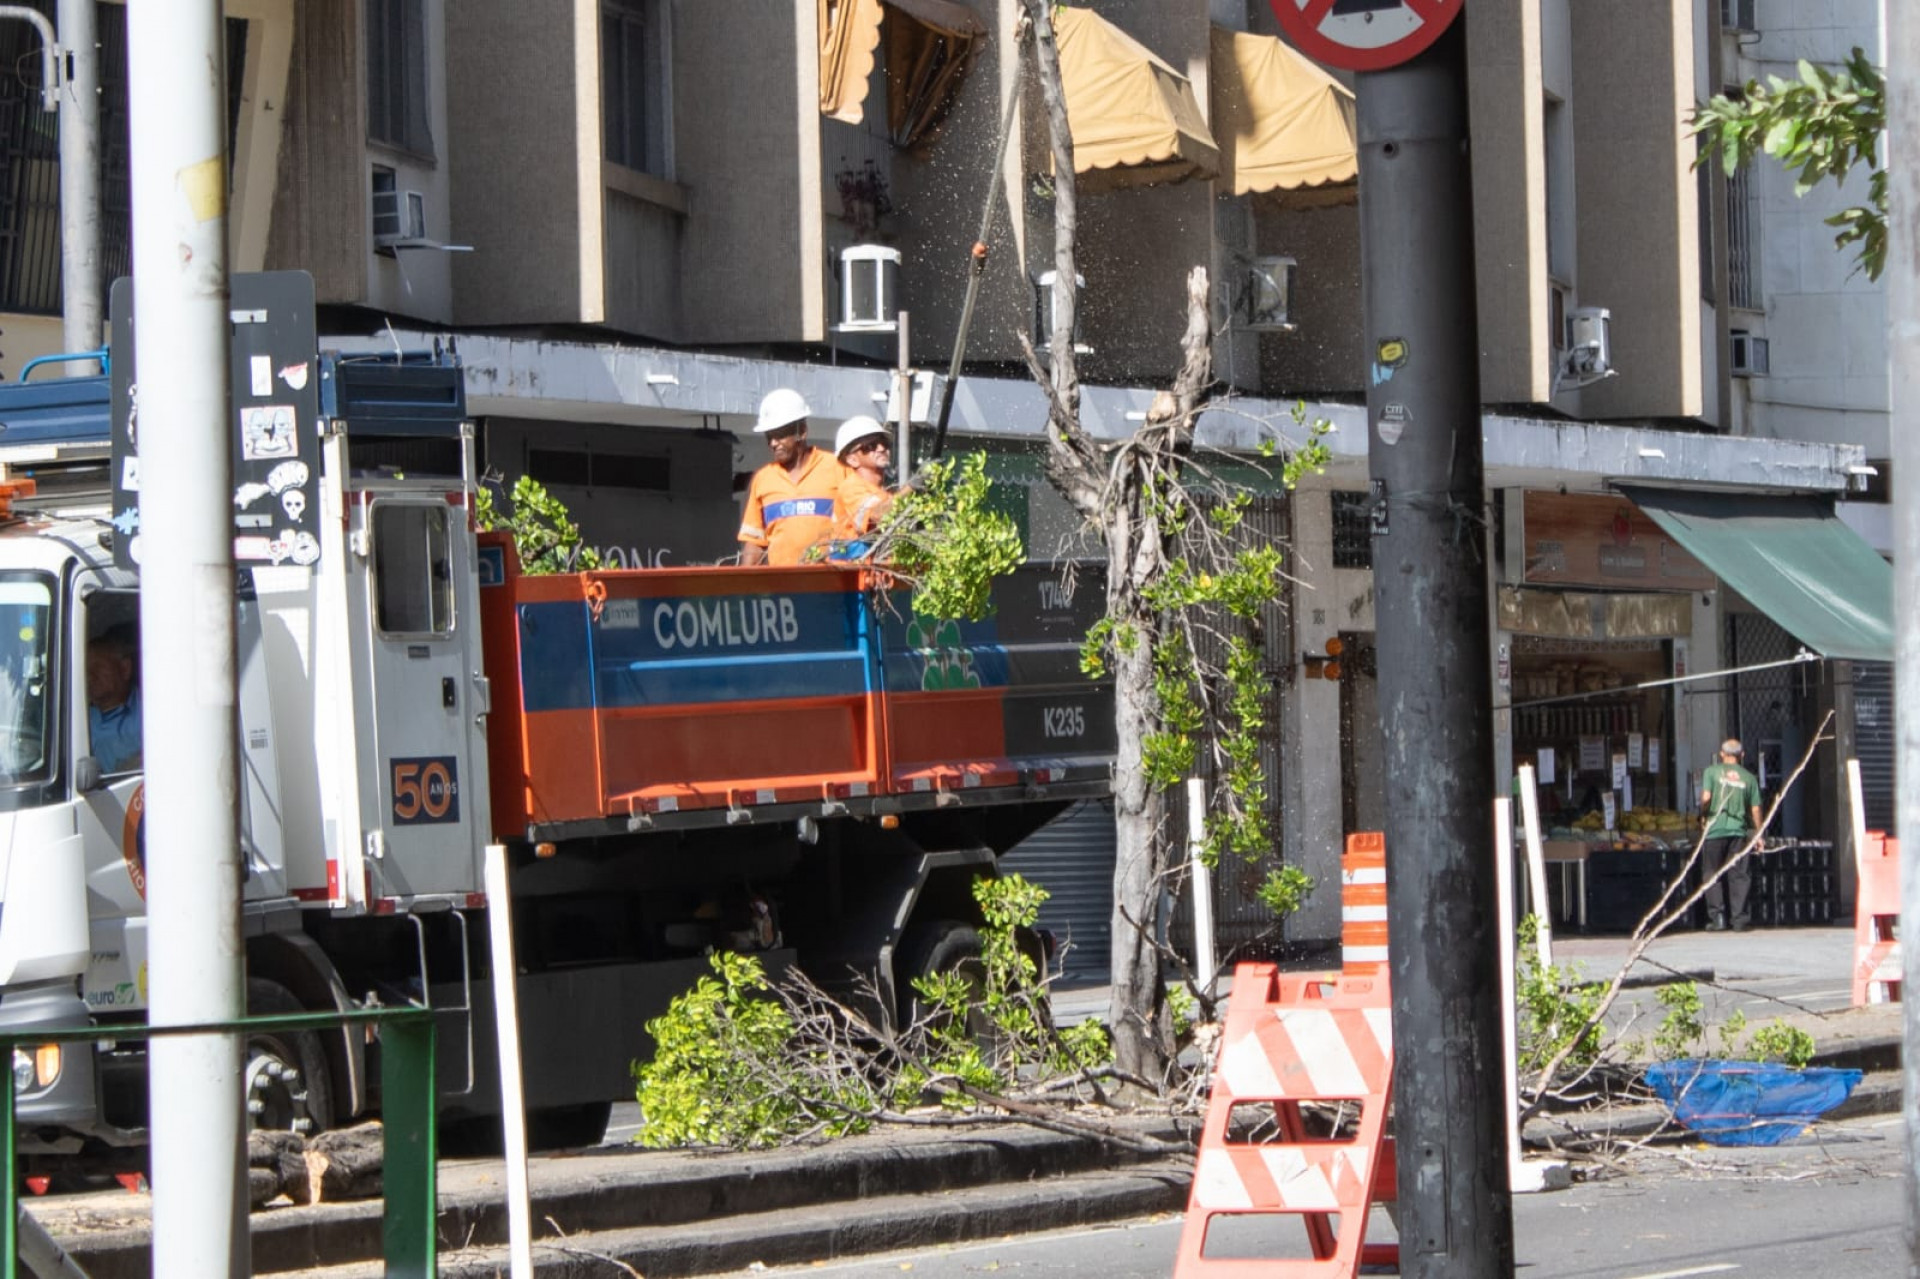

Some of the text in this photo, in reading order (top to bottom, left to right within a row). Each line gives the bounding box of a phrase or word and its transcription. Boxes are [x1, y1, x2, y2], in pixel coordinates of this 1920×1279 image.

[796, 501, 816, 511] RIO
[653, 597, 799, 649] COMLURB
[1043, 706, 1085, 738] K235
[394, 761, 451, 819] 50
